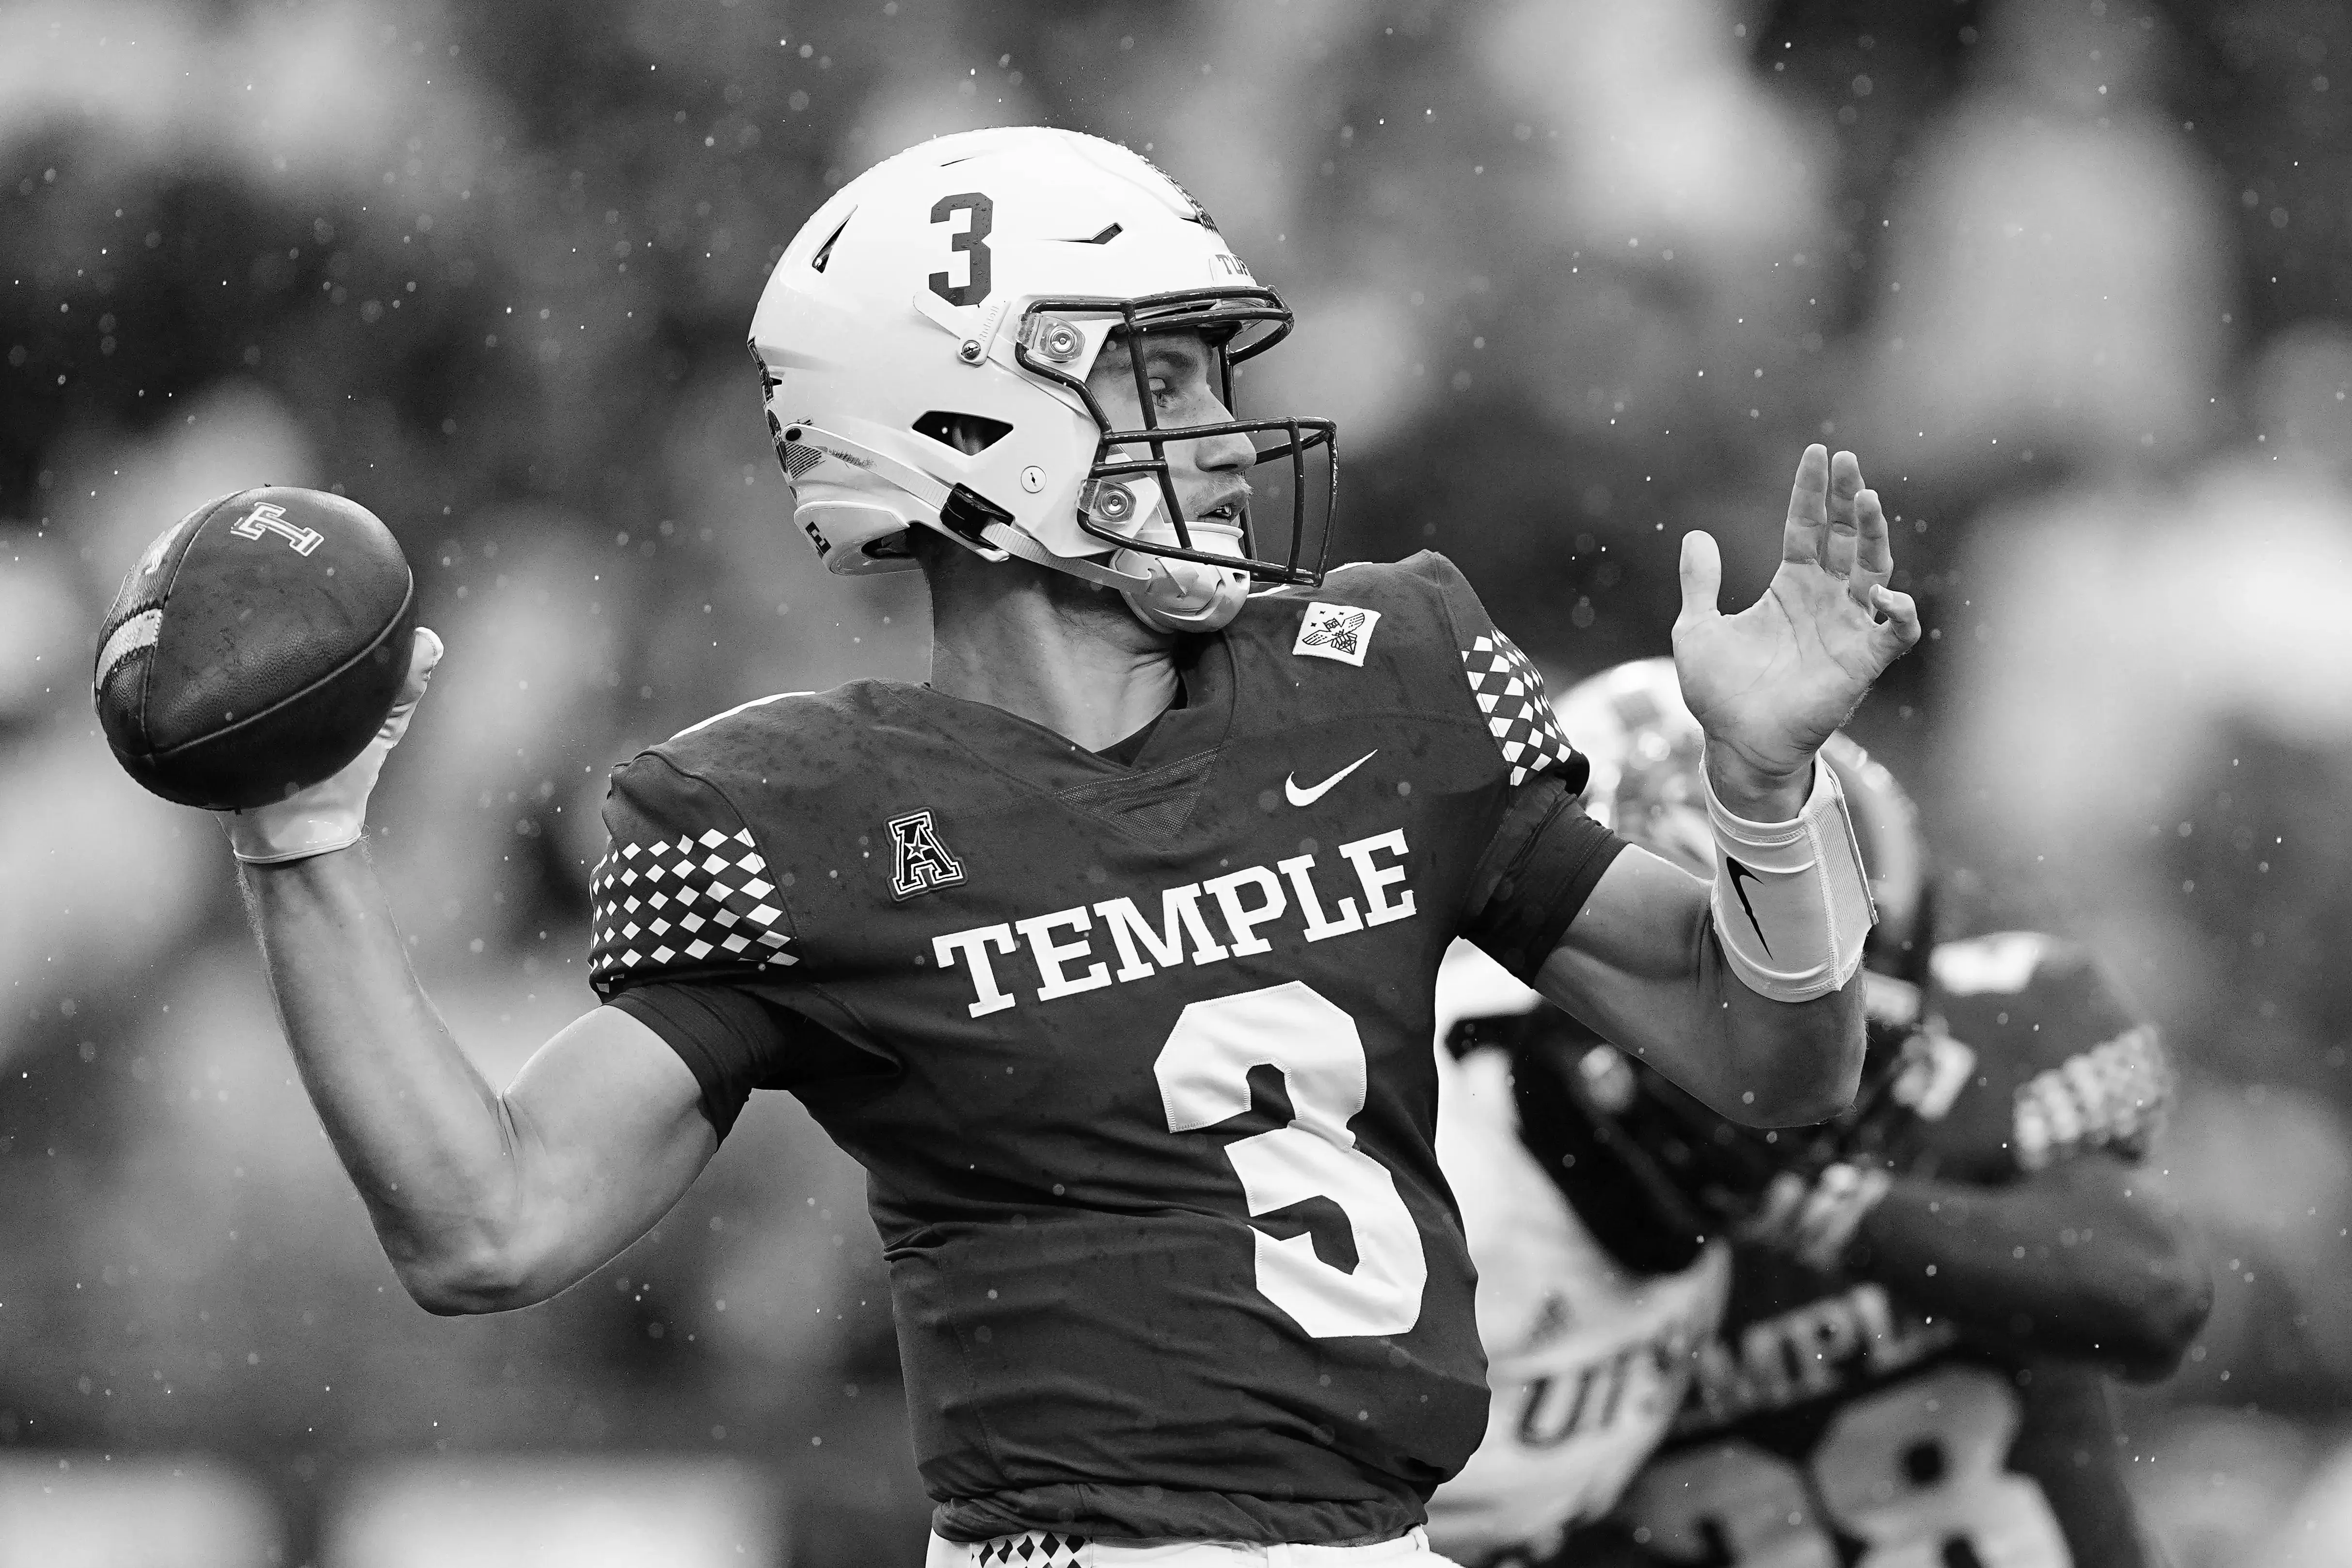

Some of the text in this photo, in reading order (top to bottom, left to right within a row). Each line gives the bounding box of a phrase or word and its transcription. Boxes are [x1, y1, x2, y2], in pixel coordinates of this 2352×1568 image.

[929, 192, 993, 307] 3
[230, 501, 325, 557] T
[888, 811, 964, 895] A
[932, 828, 1417, 1019] TEMPLE
[1153, 980, 1428, 1339] 3
